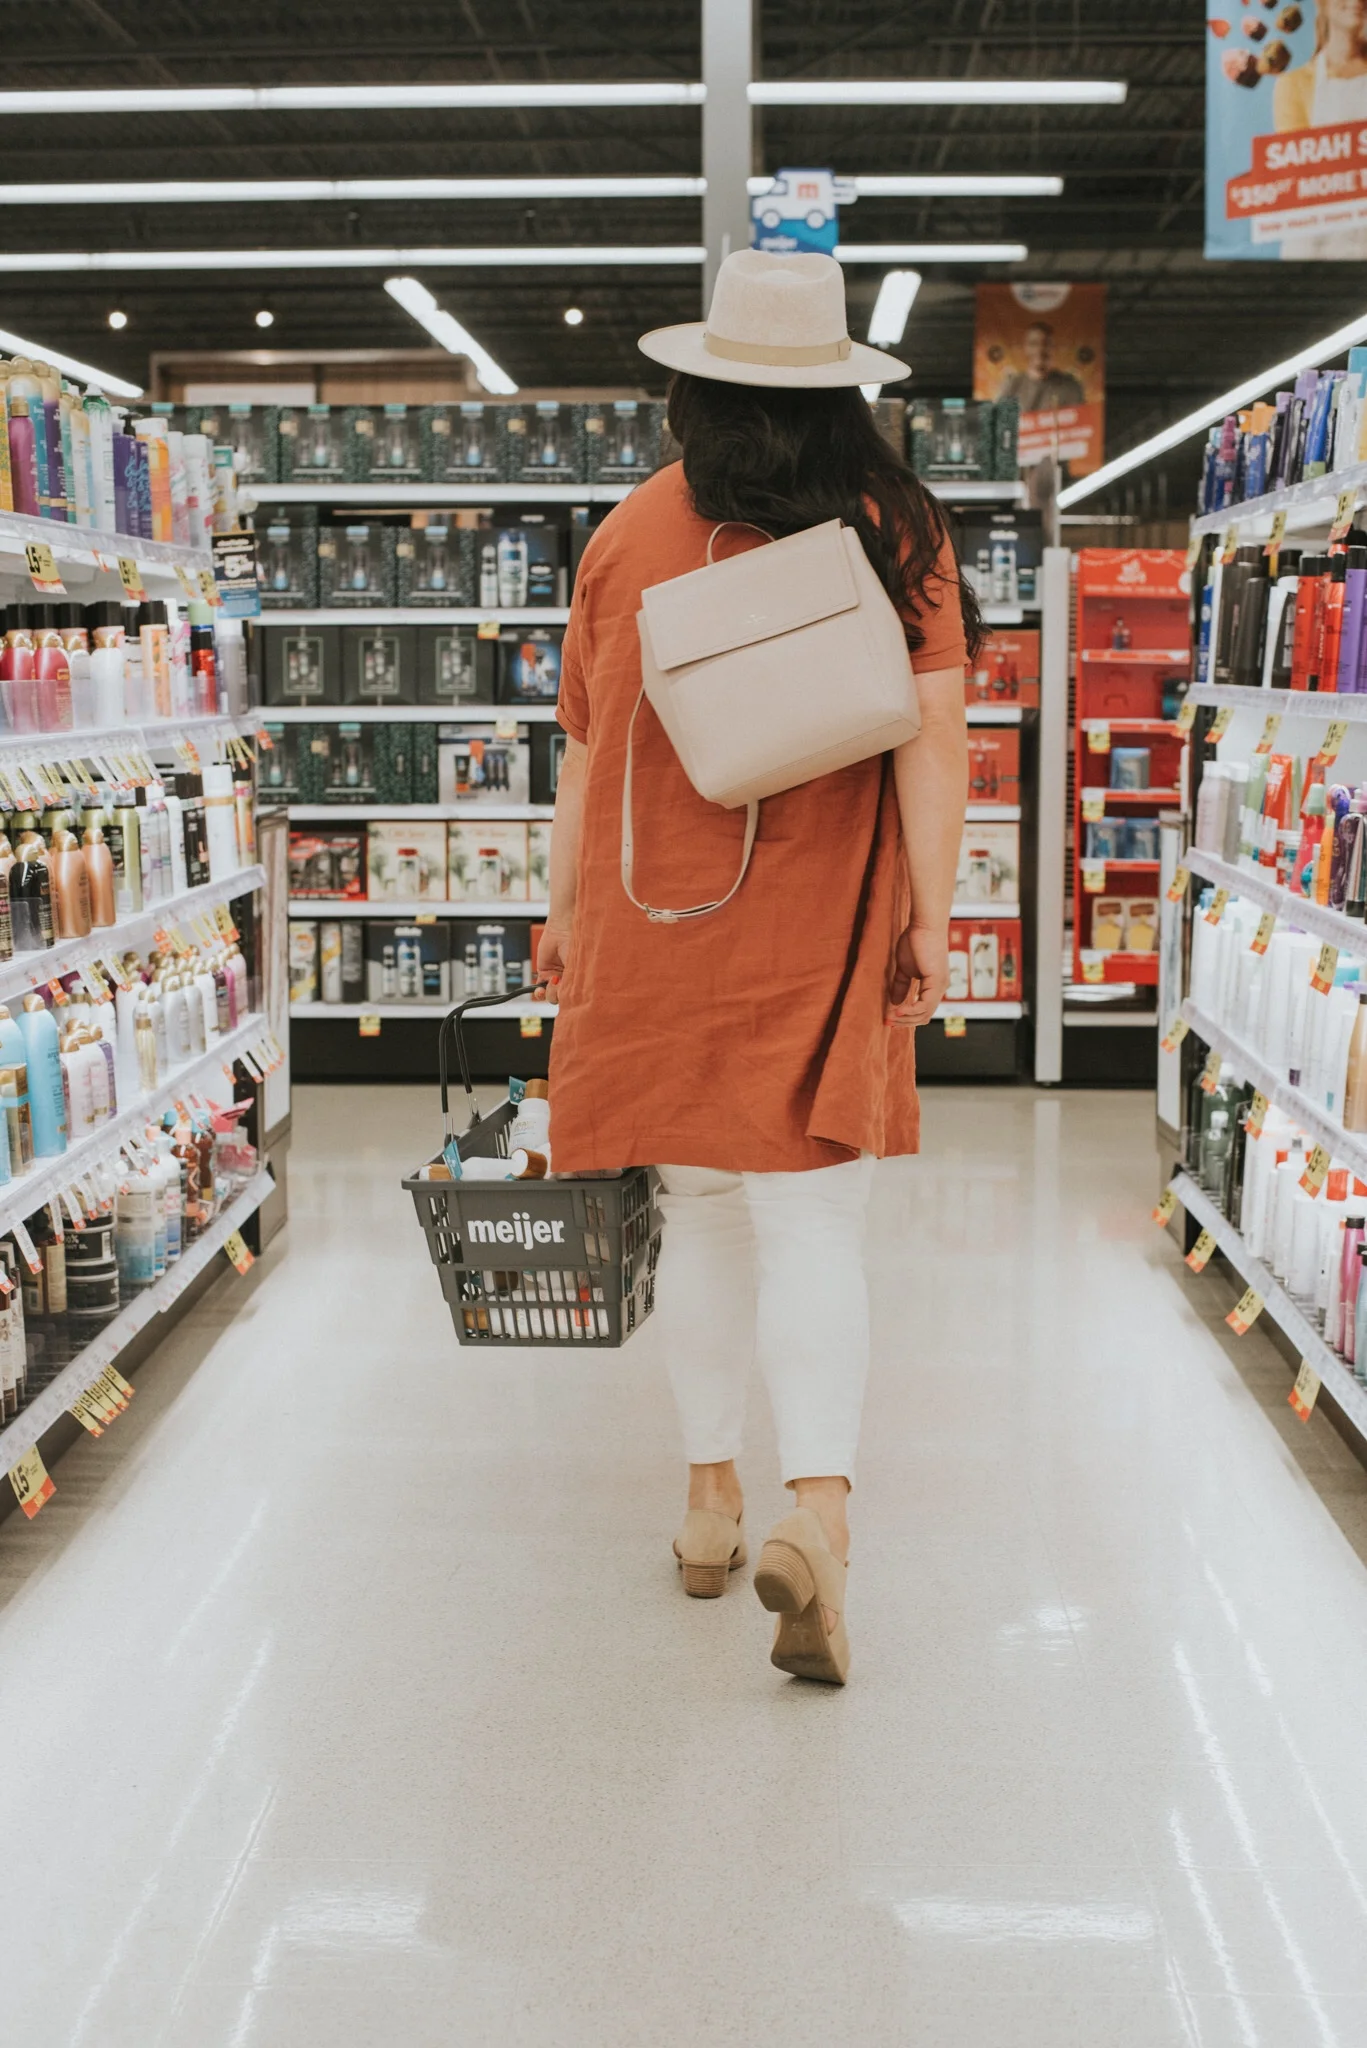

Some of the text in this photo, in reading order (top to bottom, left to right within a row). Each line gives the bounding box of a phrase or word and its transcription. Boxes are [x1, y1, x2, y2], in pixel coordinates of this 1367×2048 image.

[1264, 131, 1352, 170] SARAH
[467, 1211, 565, 1251] meijer
[12, 1465, 30, 1500] 15
